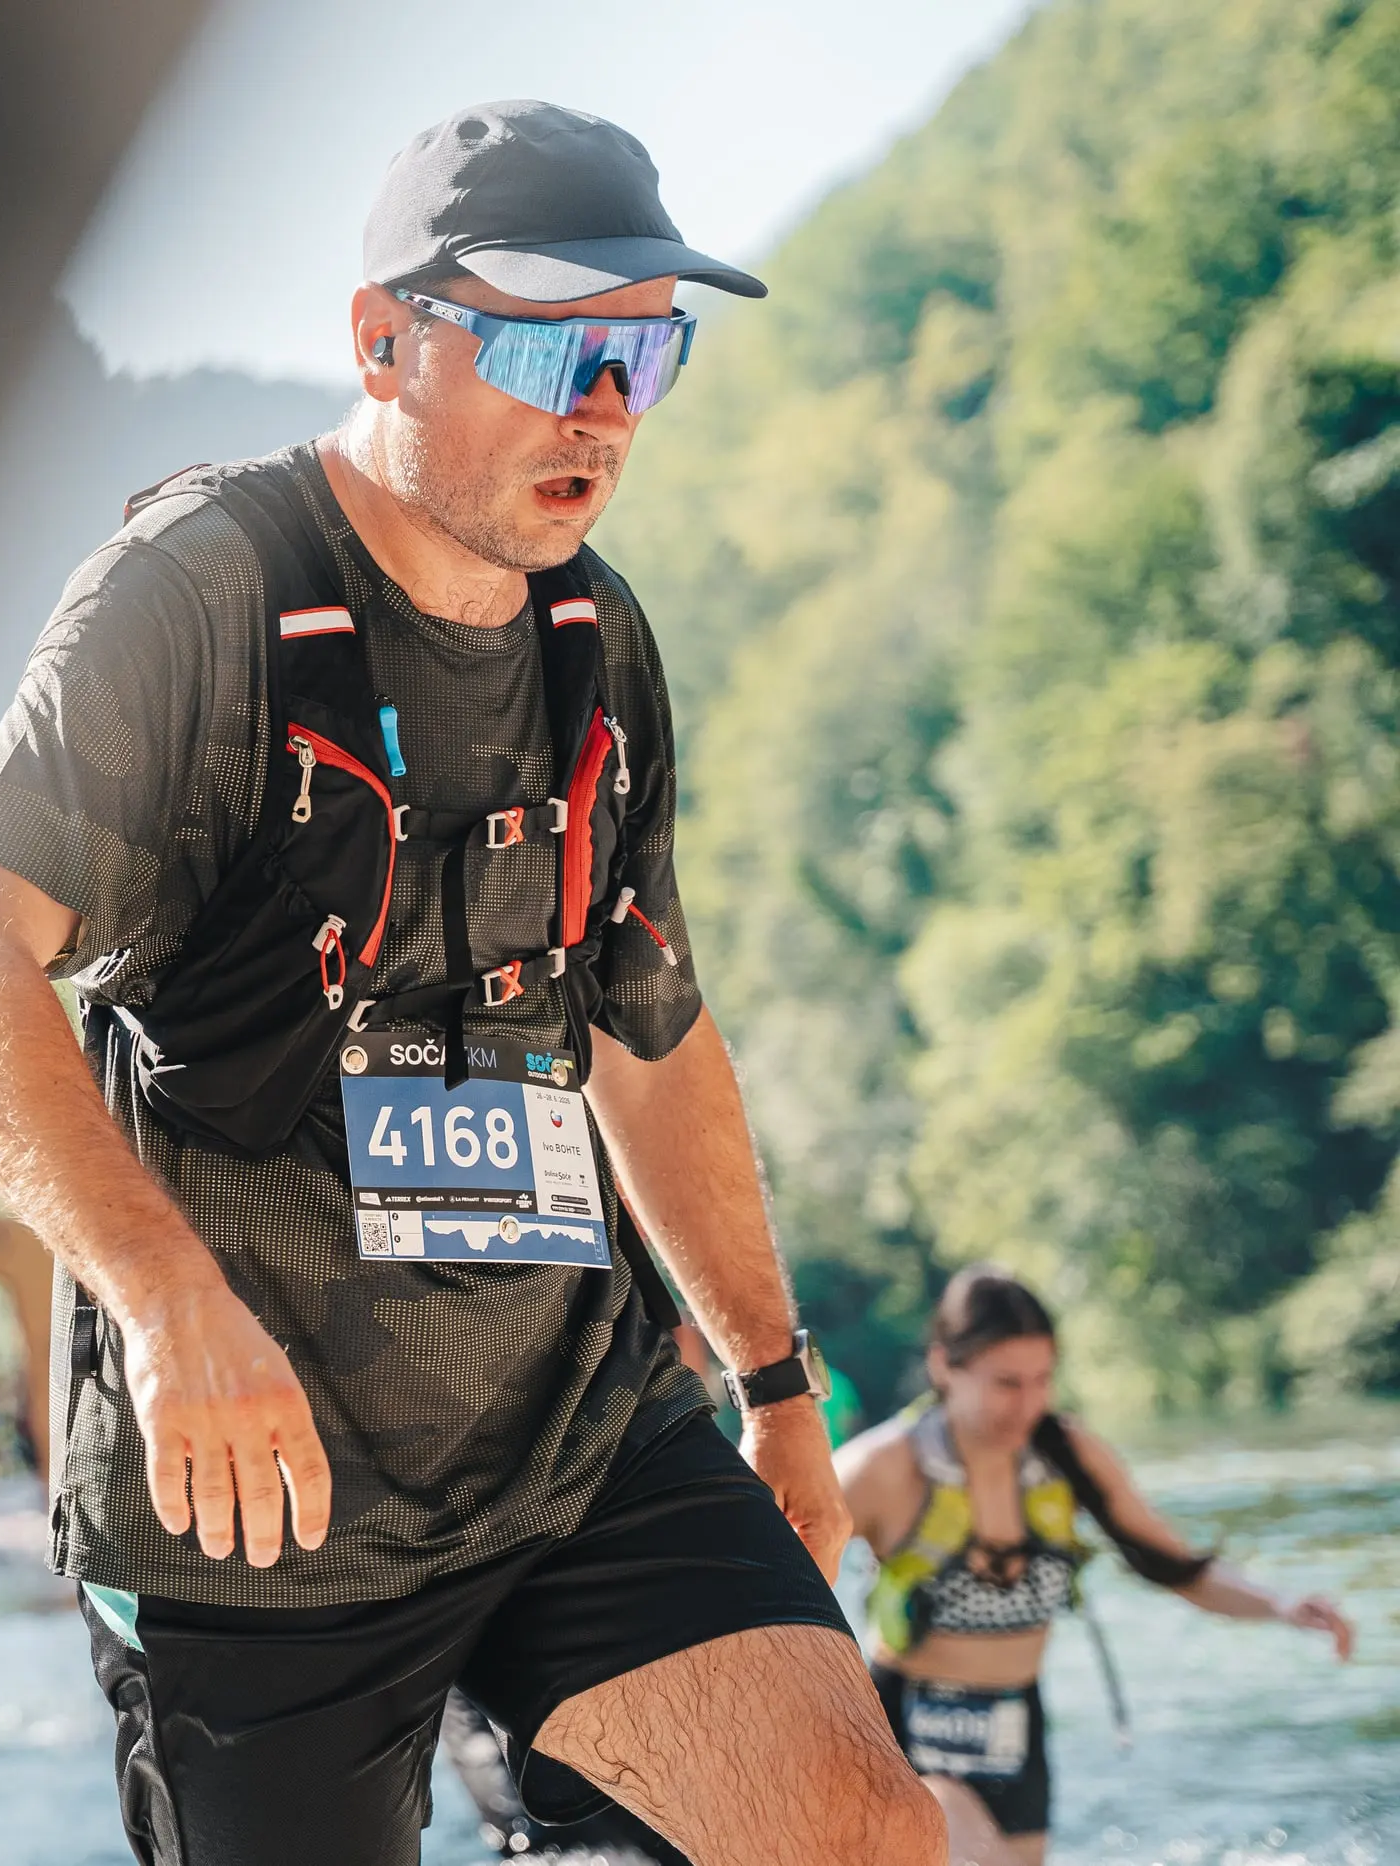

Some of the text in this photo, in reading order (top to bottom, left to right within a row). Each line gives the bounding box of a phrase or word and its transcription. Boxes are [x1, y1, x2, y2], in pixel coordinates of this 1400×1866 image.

[367, 1105, 519, 1169] 4168
[542, 1141, 582, 1156] Ivo BOHTE
